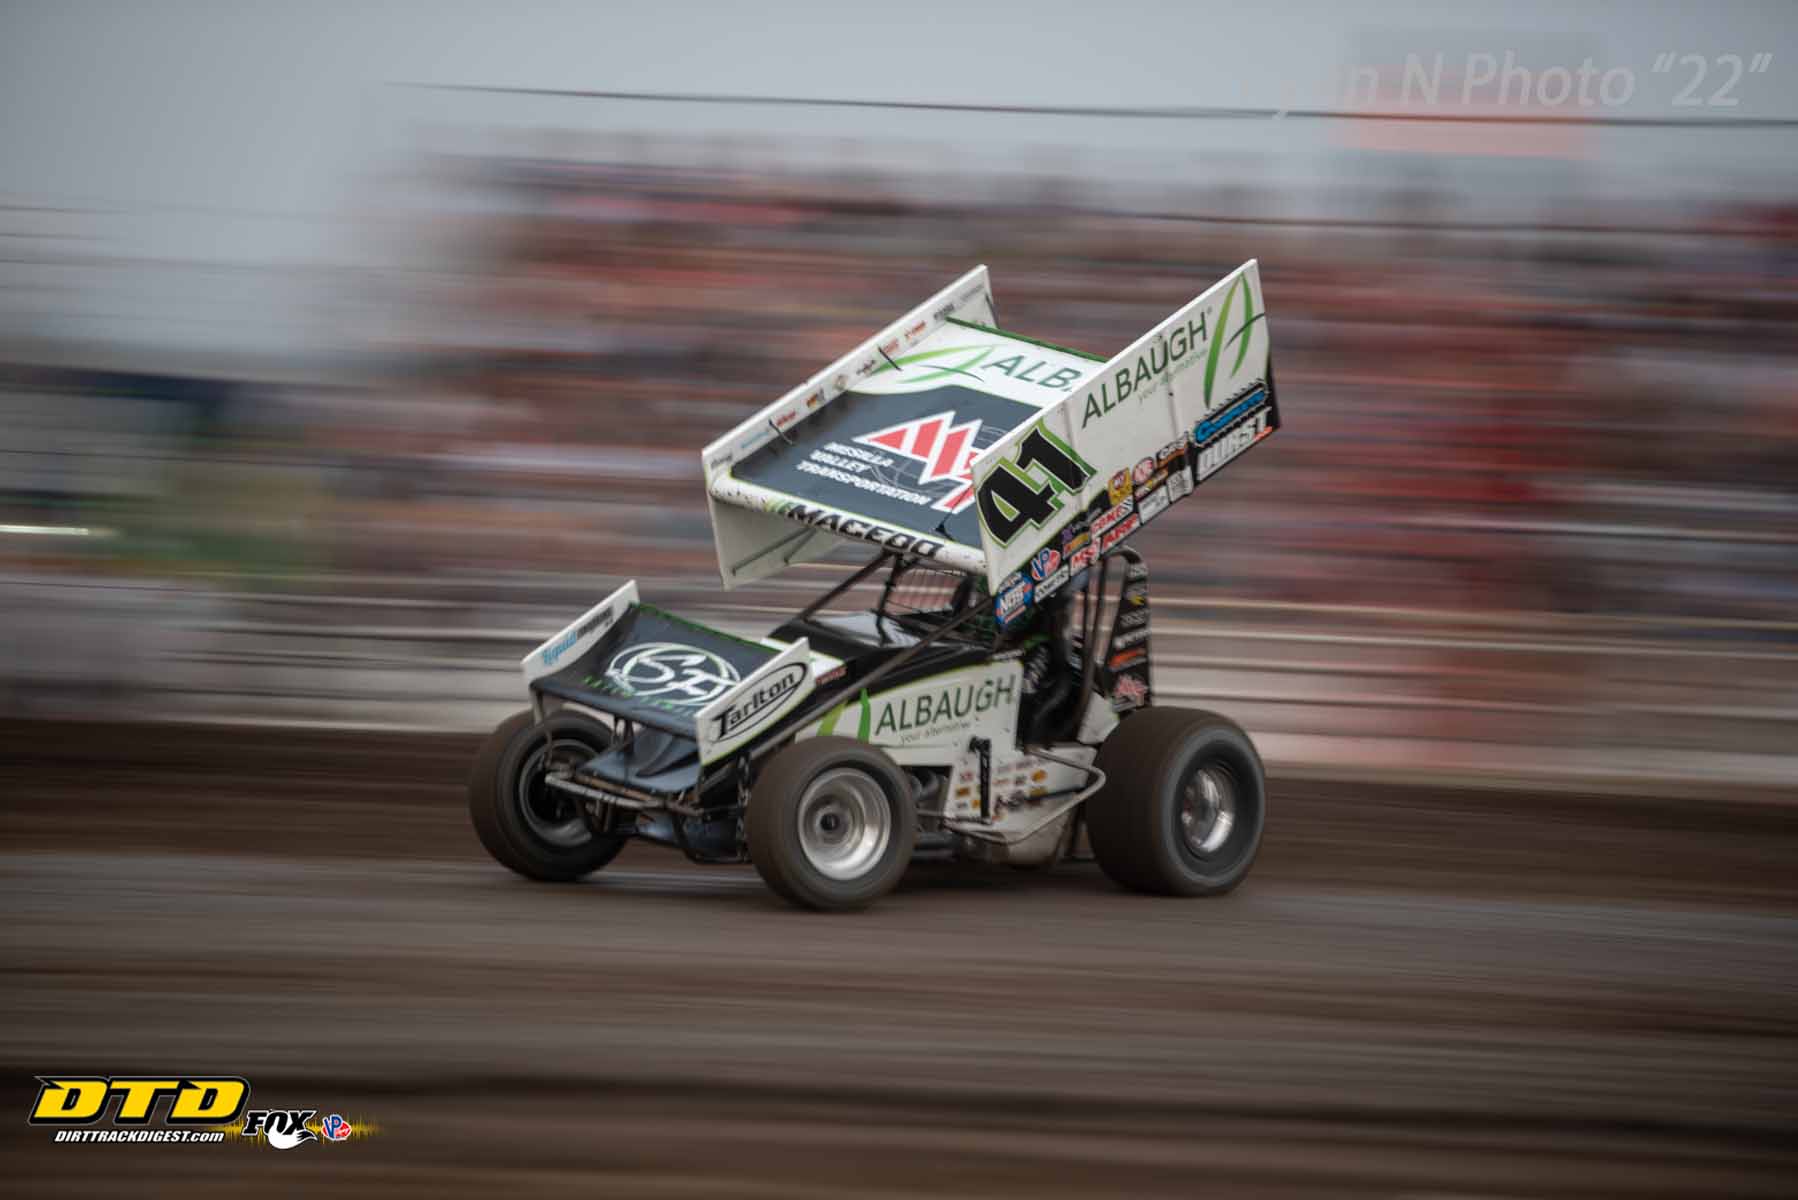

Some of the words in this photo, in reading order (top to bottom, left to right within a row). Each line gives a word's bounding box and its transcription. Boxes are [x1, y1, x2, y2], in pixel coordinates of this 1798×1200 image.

[1082, 312, 1207, 429] ALBAUGH
[796, 460, 933, 505] TRANSPORTATION
[810, 449, 872, 473] VALLEY
[977, 424, 1096, 547] 41
[787, 504, 944, 557] MACEDO
[713, 672, 796, 740] Tarlton
[875, 674, 1016, 736] ALBAUGH
